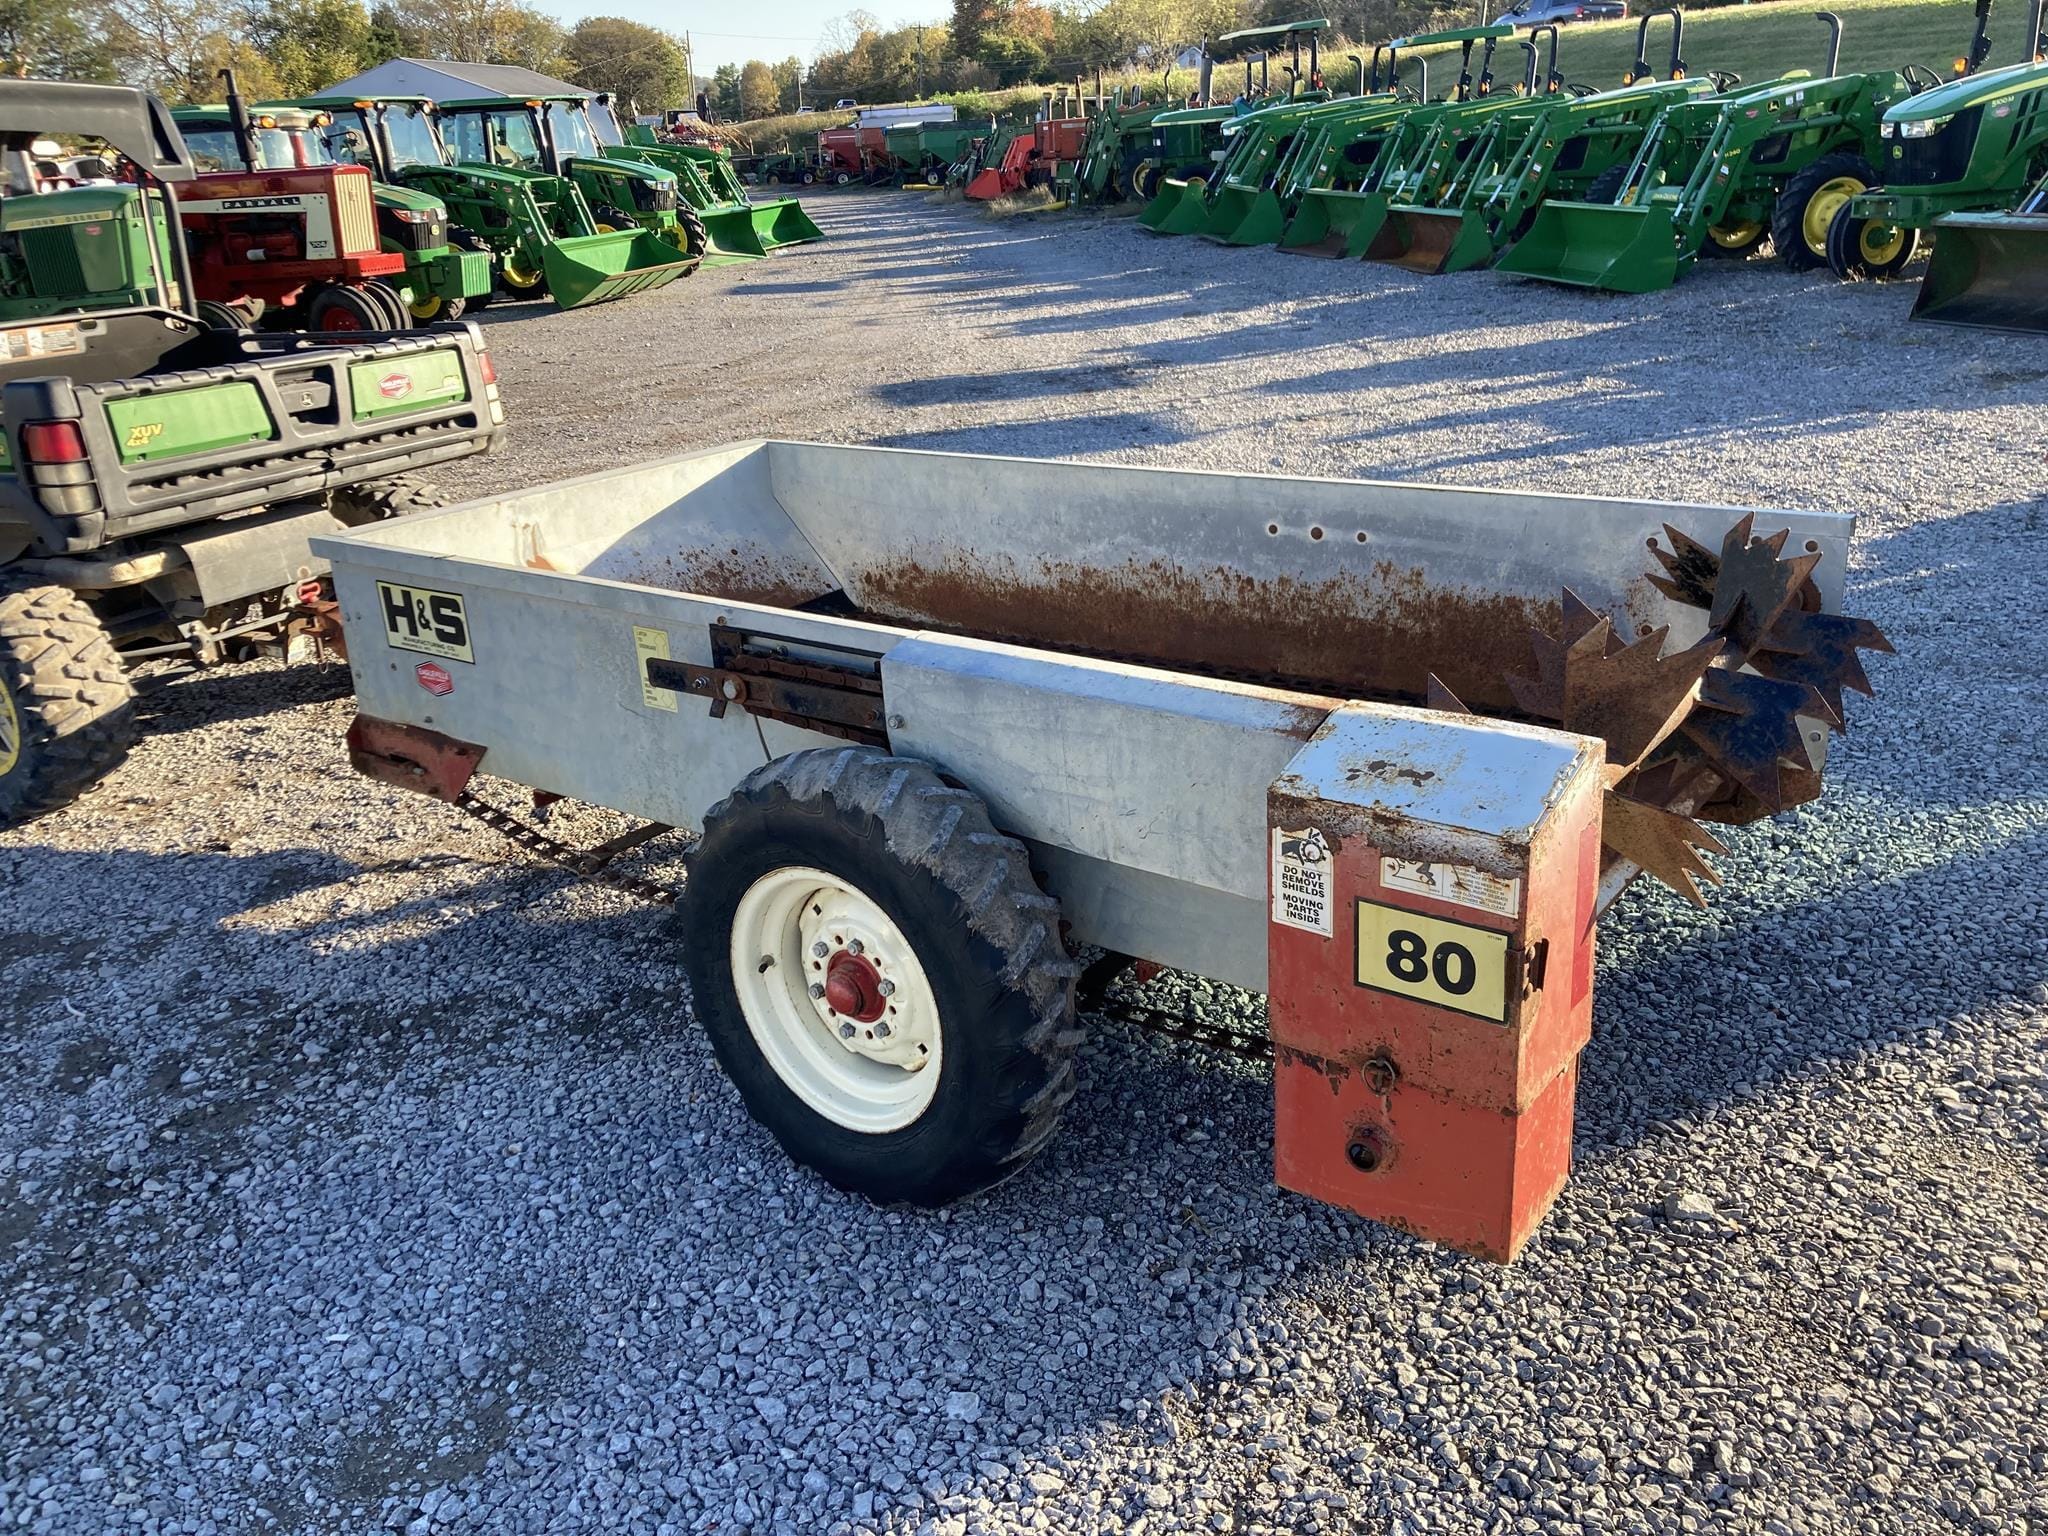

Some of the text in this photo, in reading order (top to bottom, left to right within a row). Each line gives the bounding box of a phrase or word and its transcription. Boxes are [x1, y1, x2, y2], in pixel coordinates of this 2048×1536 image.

[224, 198, 300, 208] FARMALL
[129, 423, 163, 438] XUV
[381, 585, 467, 647] H&S
[1283, 865, 1322, 881] DO NOT
[1282, 873, 1325, 890] REMOVE
[1282, 881, 1325, 898] SHIELDS
[1283, 893, 1324, 910] MOVING
[1287, 902, 1320, 917] PARTS
[1286, 910, 1320, 925] INSIDE
[1386, 929, 1477, 996] 80
